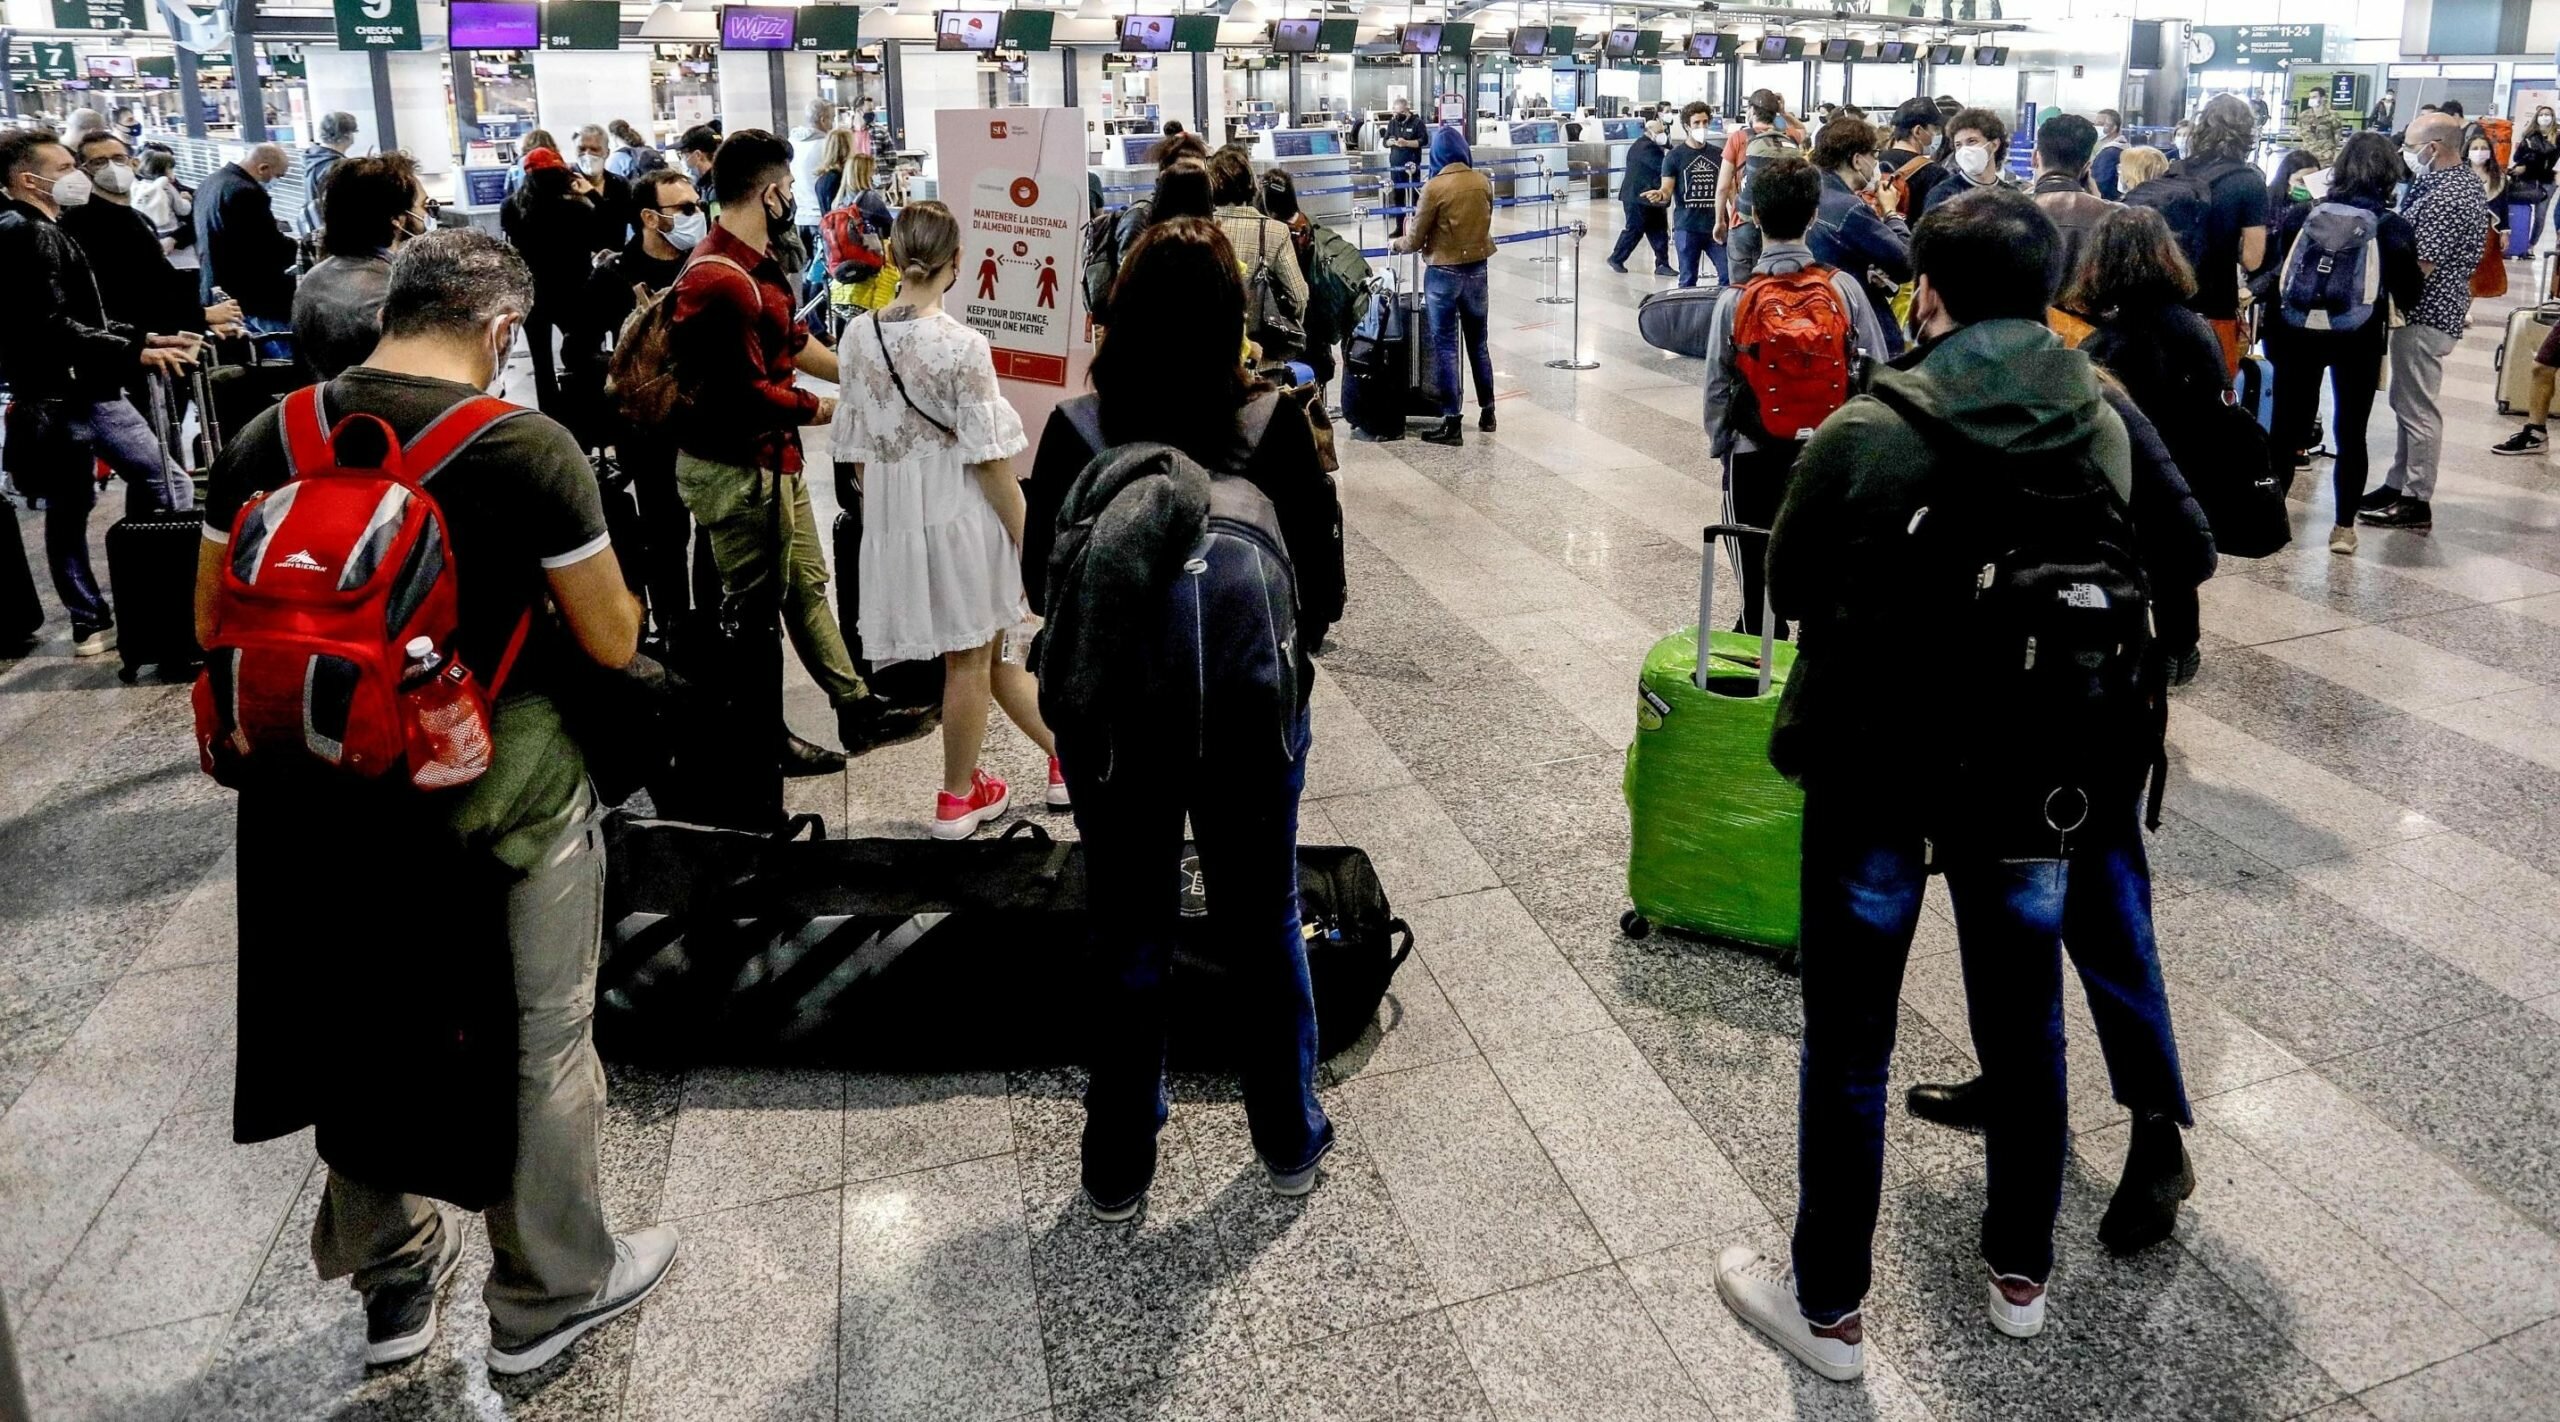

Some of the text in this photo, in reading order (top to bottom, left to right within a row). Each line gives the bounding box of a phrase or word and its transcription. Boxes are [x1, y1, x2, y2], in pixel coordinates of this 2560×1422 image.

[354, 26, 404, 35] CHECK-IN
[2183, 23, 2192, 40] 9
[2280, 25, 2311, 37] 11-24
[365, 35, 395, 44] AREA
[551, 36, 570, 46] 914
[801, 37, 817, 47] 913
[1005, 38, 1018, 48] 912
[44, 48, 63, 66] 7
[973, 208, 1068, 229] MANTENERE LA DISTANZA
[973, 219, 1052, 239] DI ALMENO UN METRO.
[966, 304, 1049, 326] KEEP YOUR DISTANCE,
[966, 315, 1044, 336] MINIMUM ONE METRE
[2071, 582, 2091, 592] THE
[2057, 590, 2090, 600] NORTH
[2067, 599, 2091, 608] FACE
